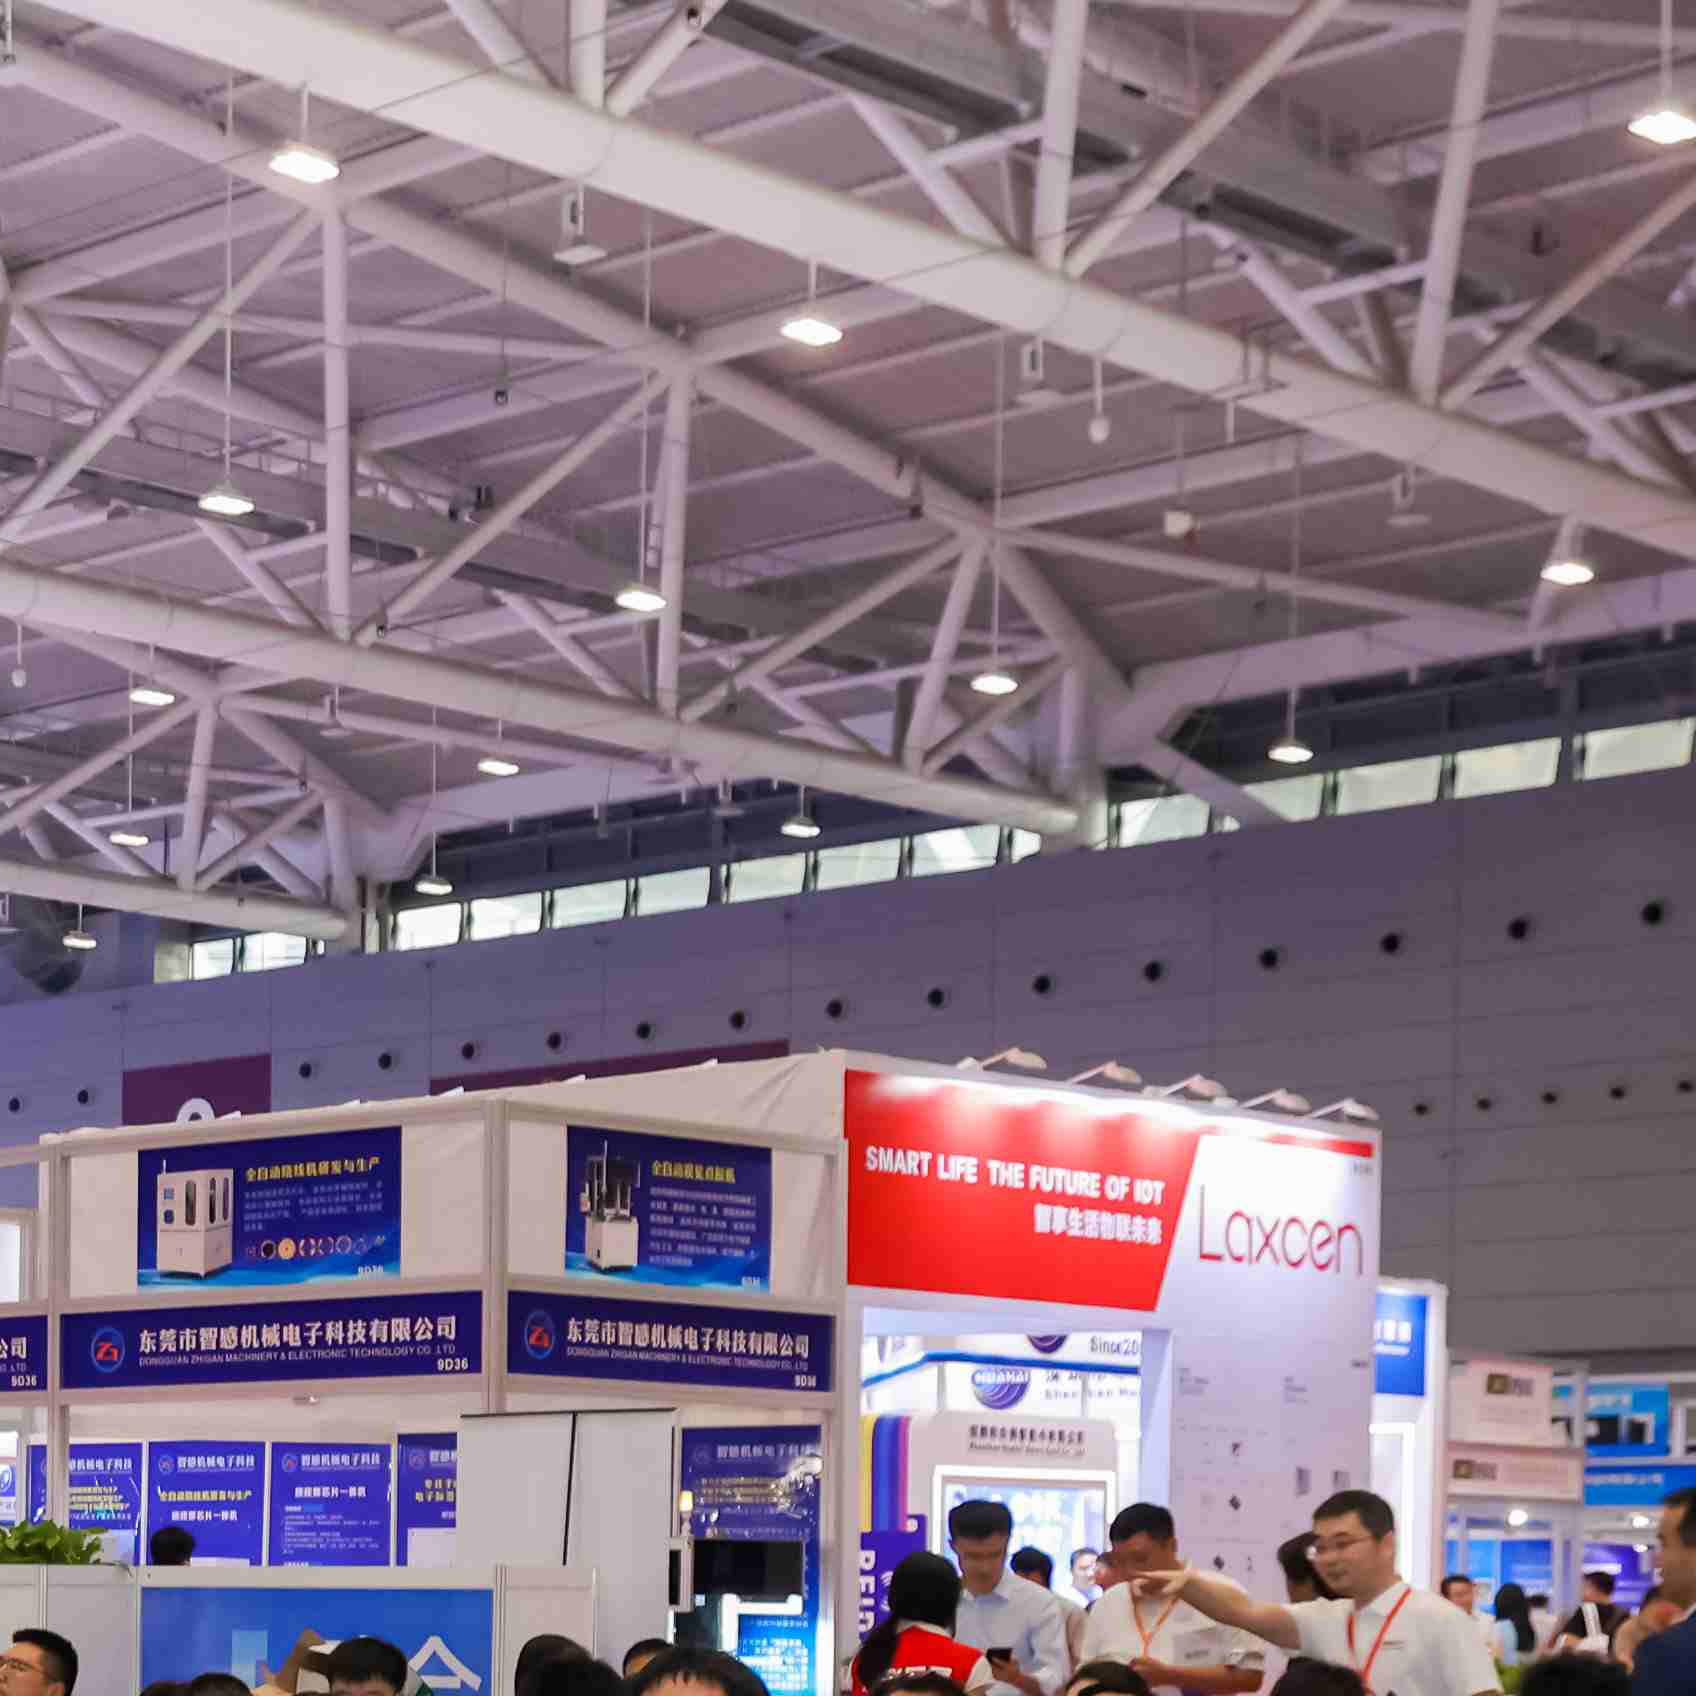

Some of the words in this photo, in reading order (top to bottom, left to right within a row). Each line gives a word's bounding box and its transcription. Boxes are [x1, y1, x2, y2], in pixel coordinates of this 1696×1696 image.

[866, 1145, 932, 1178] SMART
[936, 1153, 978, 1184] LIFE
[987, 1159, 1025, 1189] THE
[1029, 1164, 1102, 1198] FUTURE
[1104, 1175, 1131, 1201] OF
[1133, 1179, 1166, 1205] IOT
[1198, 1183, 1363, 1278] Laxcen
